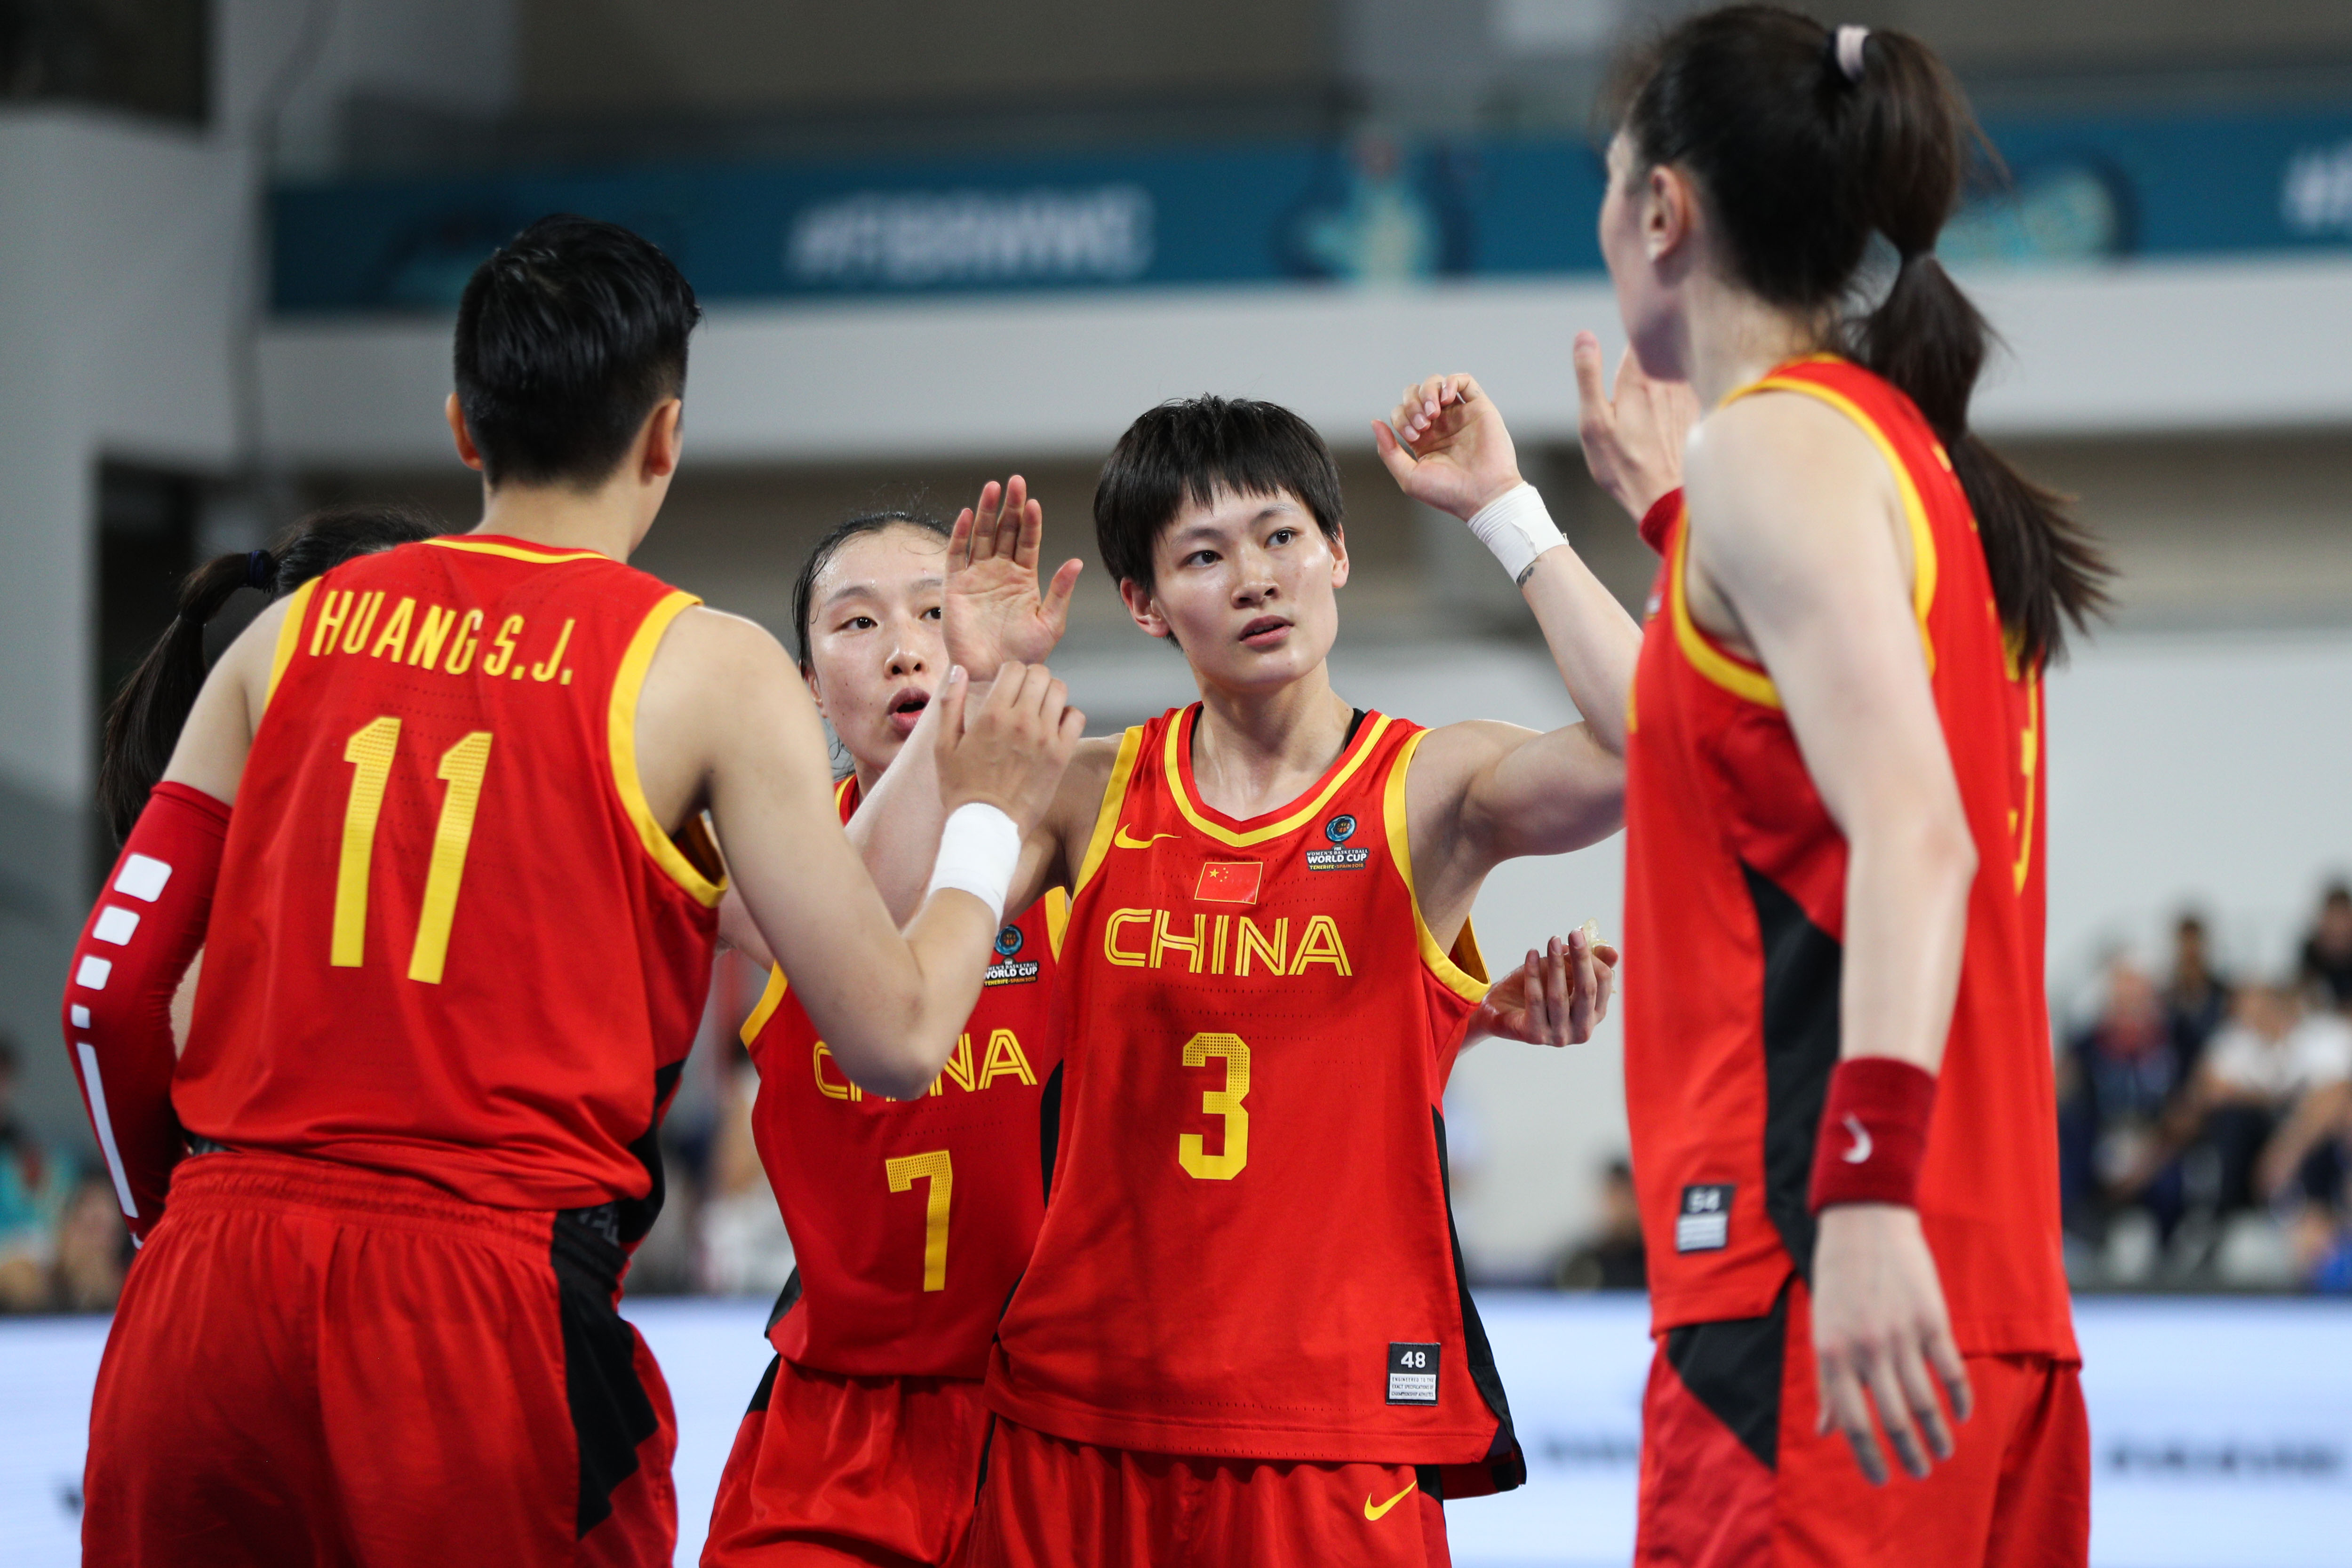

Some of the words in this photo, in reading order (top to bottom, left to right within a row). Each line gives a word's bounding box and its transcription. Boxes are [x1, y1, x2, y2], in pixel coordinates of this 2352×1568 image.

[309, 590, 483, 675] HUANG
[484, 614, 575, 685] S.J.
[330, 716, 493, 984] 11
[1308, 854, 1344, 864] WORLD
[1347, 853, 1367, 862] CUP
[1019, 967, 1037, 976] CUP
[1104, 907, 1353, 977] CHINA
[813, 1028, 1038, 1102] CNA
[1179, 1032, 1251, 1180] 3
[885, 1149, 953, 1292] 7
[1401, 1351, 1426, 1369] 48
